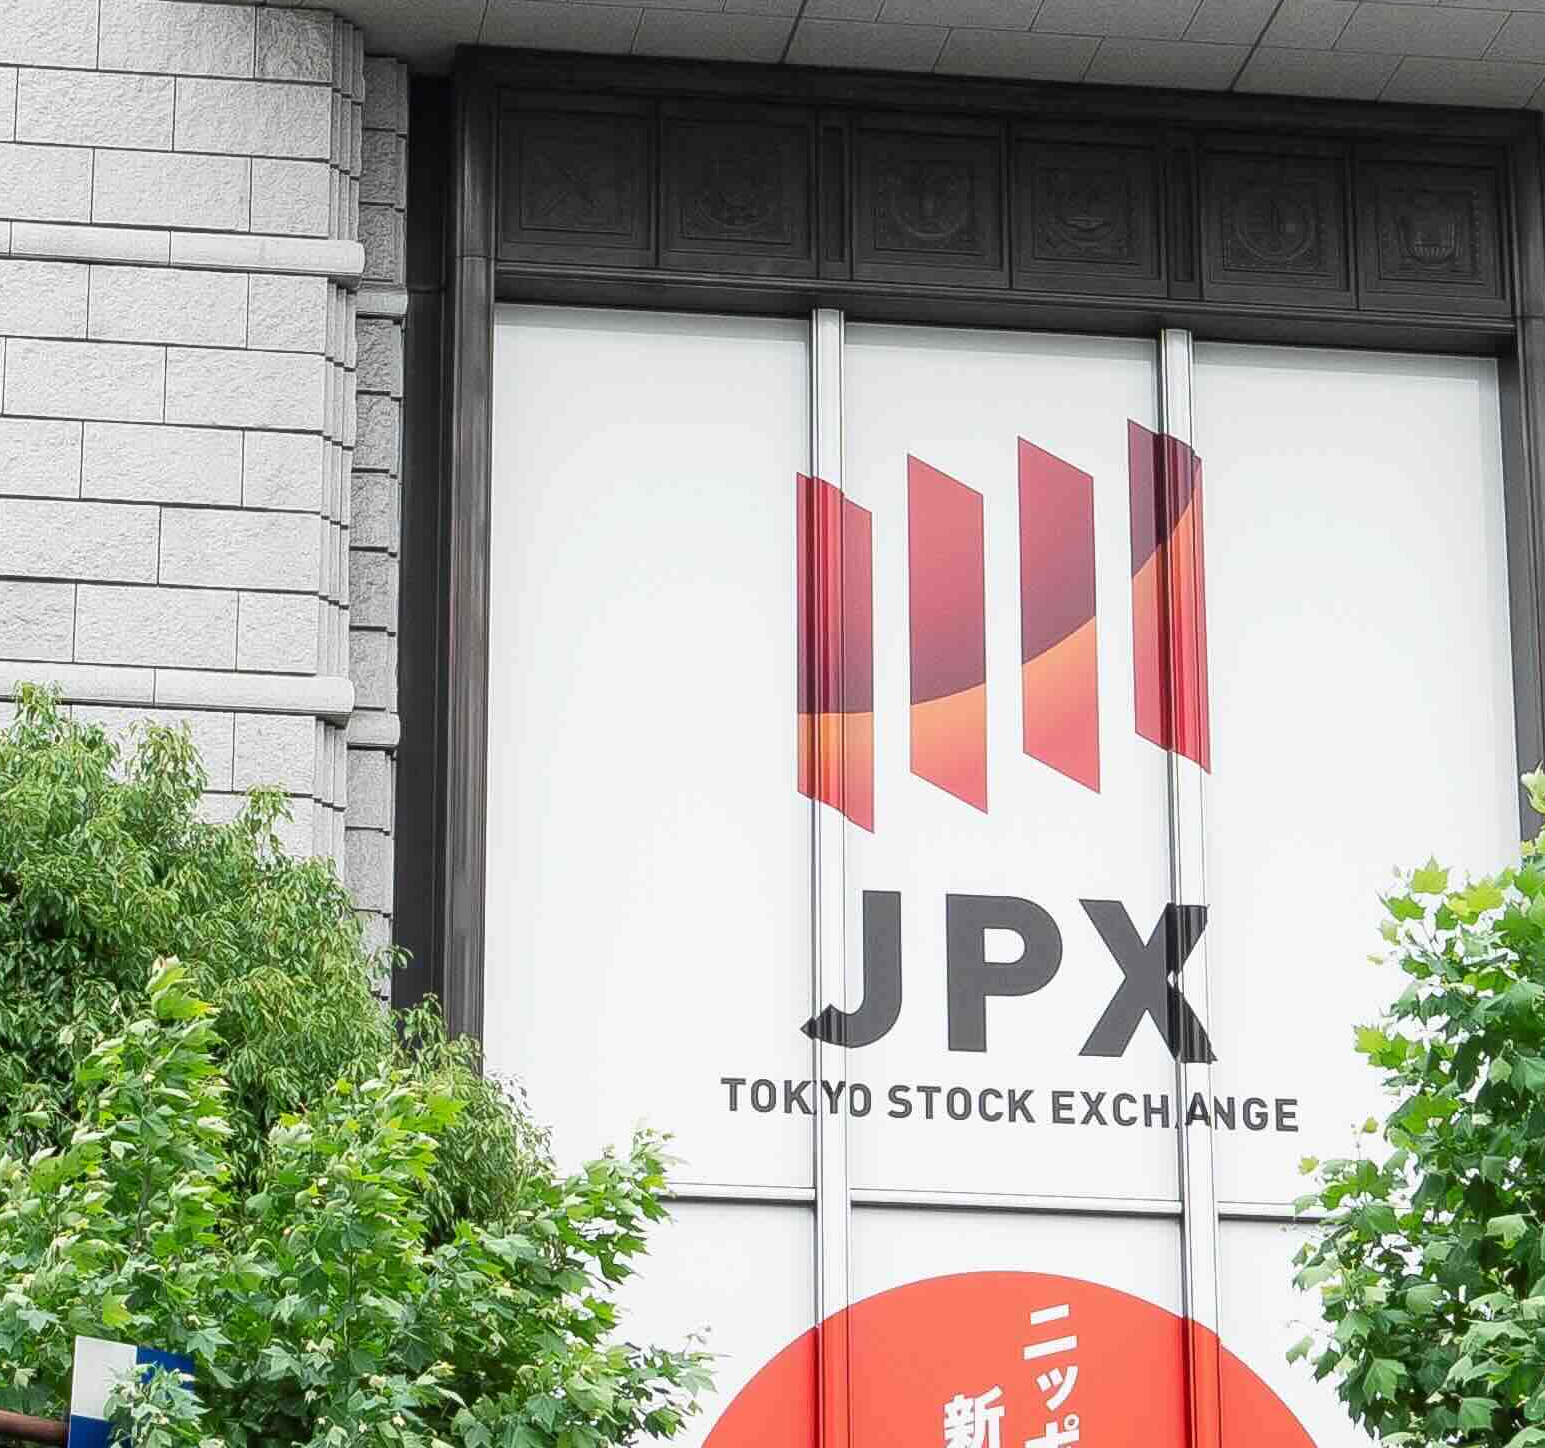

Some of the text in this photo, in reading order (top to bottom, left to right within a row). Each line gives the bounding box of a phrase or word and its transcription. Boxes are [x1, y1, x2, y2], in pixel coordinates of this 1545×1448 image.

[800, 889, 1217, 1063] JPX
[722, 1077, 1299, 1133] TOKYO STOCK EXCHANGE
